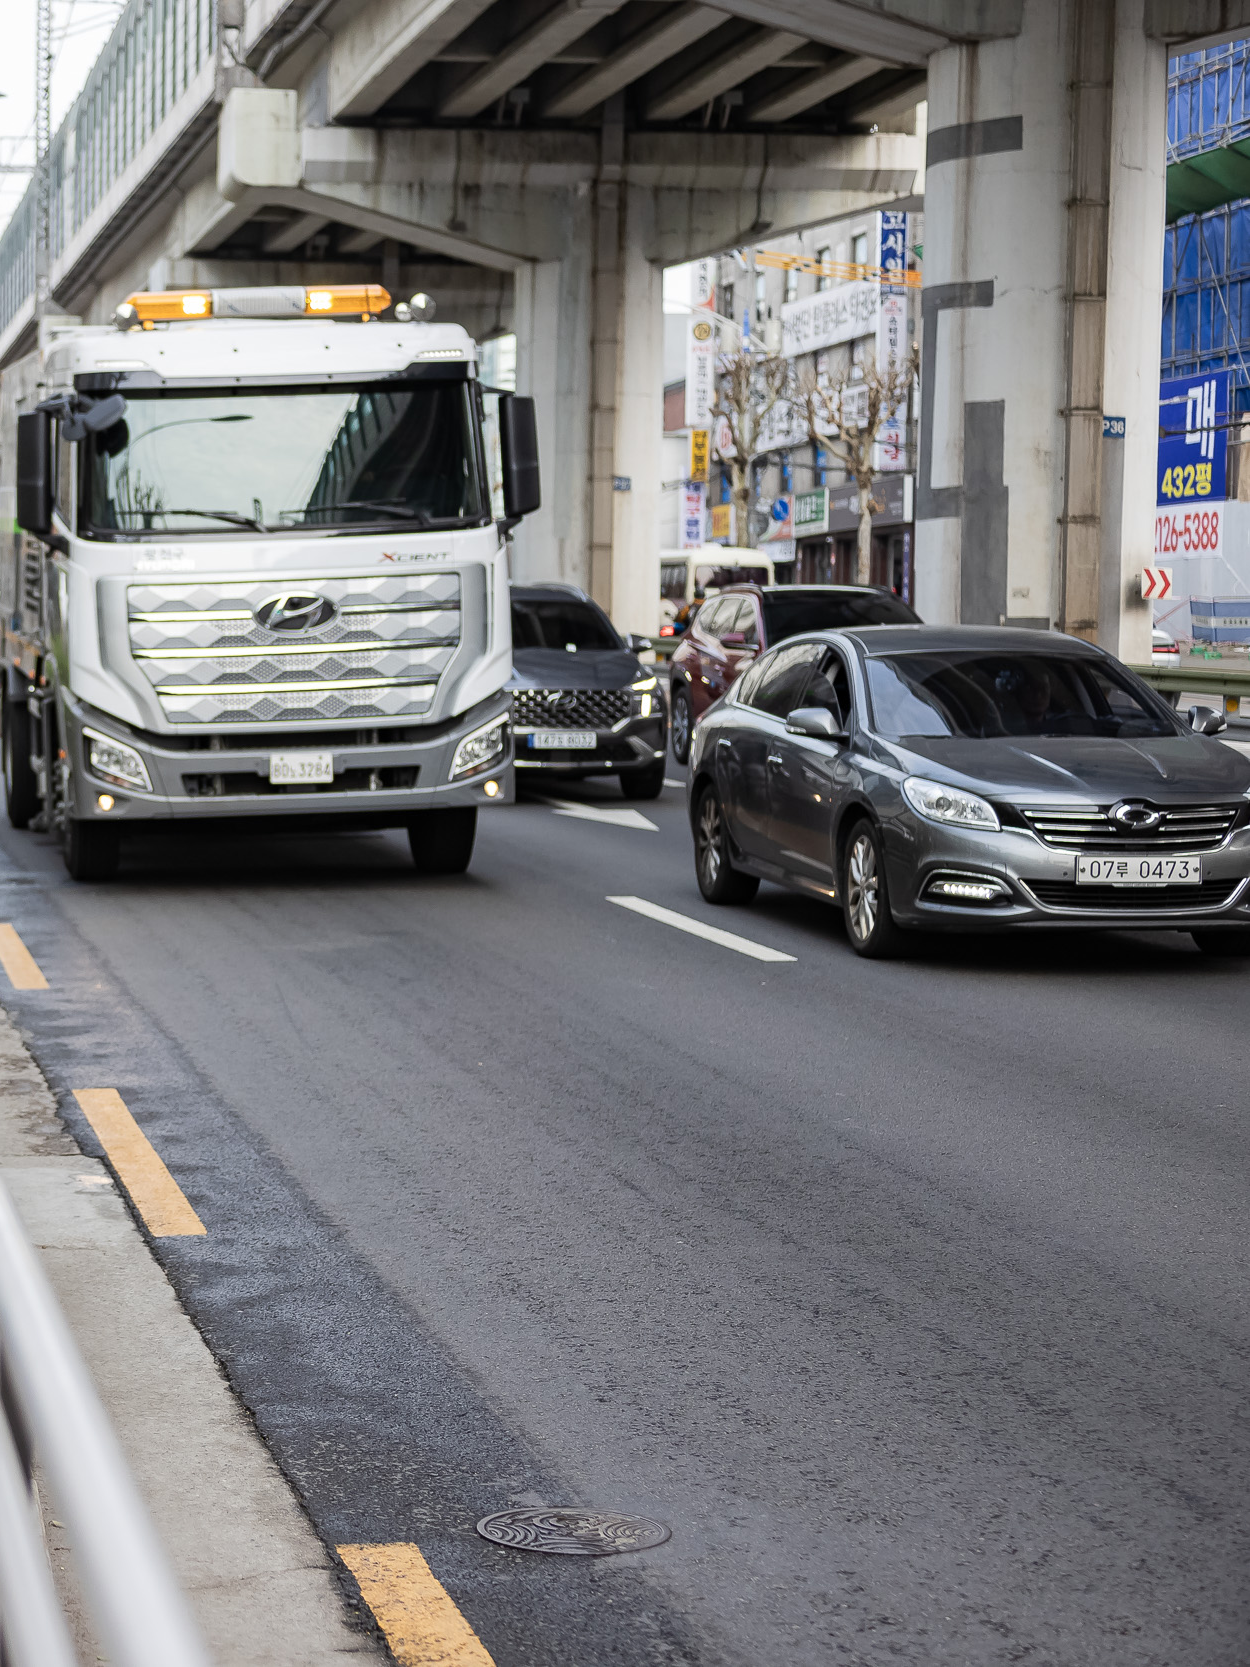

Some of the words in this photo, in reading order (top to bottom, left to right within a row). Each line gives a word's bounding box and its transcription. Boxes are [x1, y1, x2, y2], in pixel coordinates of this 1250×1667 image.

[1161, 462, 1212, 498] 432평
[1155, 511, 1219, 553] 126-5388
[377, 551, 451, 563] XCIENT
[1090, 860, 1128, 879] 07루
[1139, 860, 1190, 879] 0473
